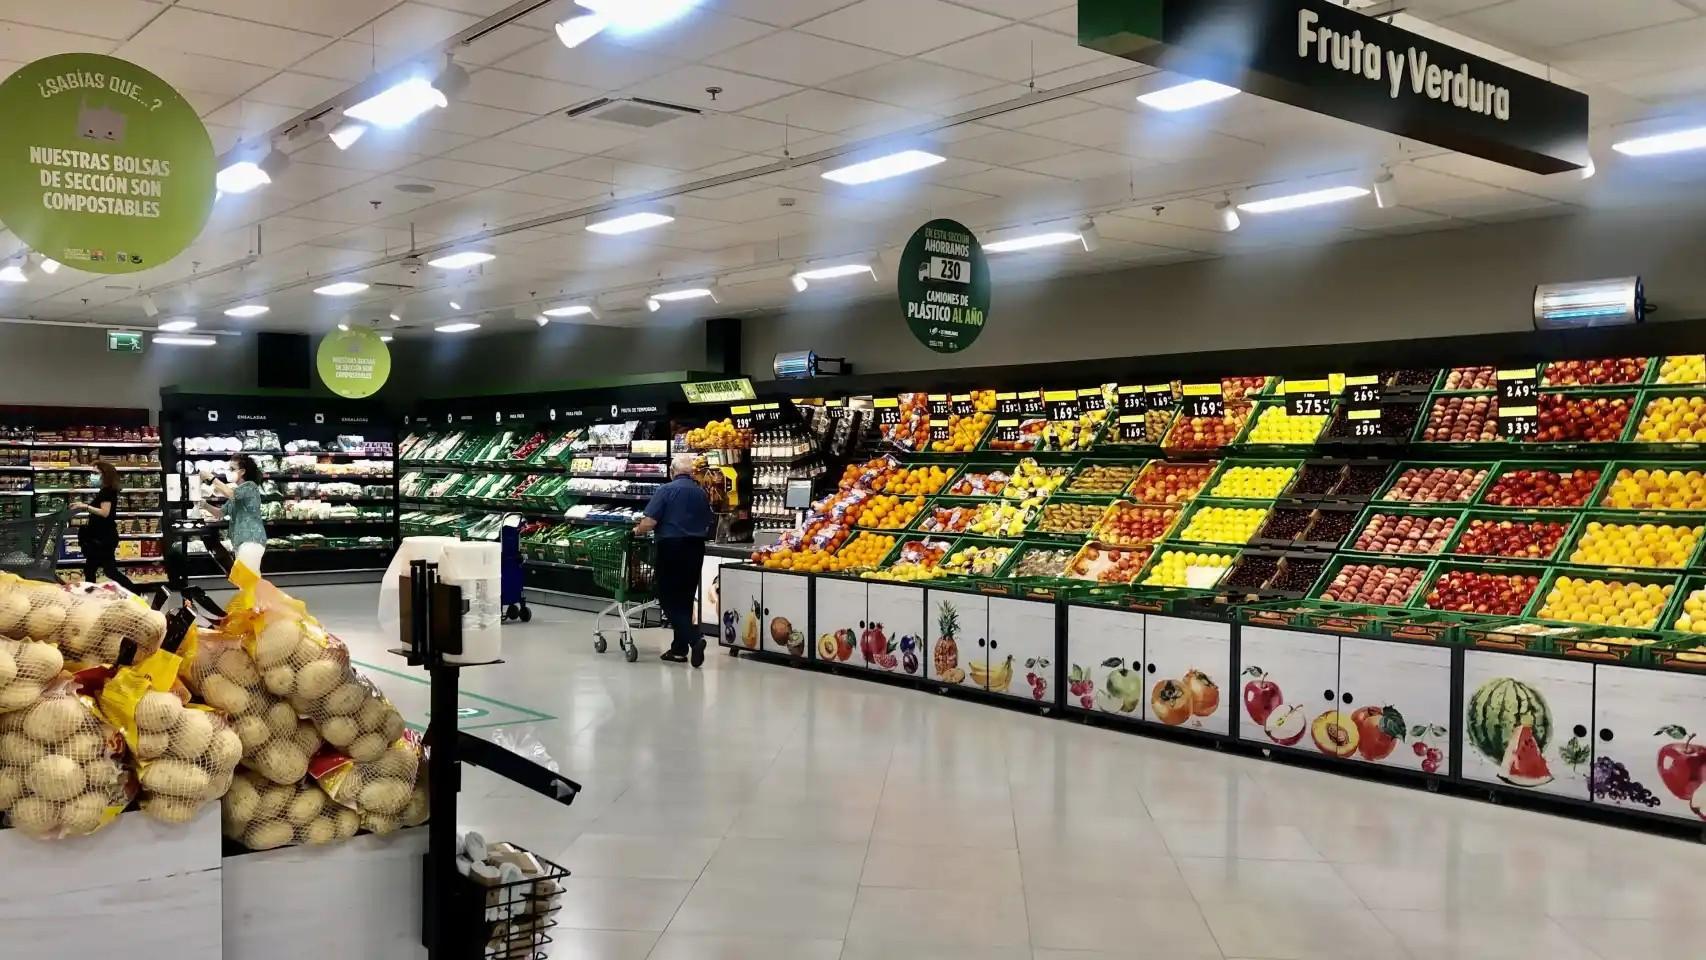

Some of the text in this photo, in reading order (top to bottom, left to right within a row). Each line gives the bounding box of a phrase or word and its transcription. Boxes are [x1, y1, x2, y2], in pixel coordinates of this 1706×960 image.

[1298, 8, 1511, 121] Fruta y Verdura
[39, 68, 105, 99] ¿SABÍAS
[29, 146, 170, 177] NUESTRAS BOLSAS
[40, 168, 161, 198] DE SECCIÓN SON
[43, 192, 160, 218] COMPOSTABLES
[925, 239, 969, 257] AHORRAMOS
[941, 260, 961, 281] 230
[926, 290, 969, 307] CAMIONES DE
[908, 301, 983, 327] PLÁSTICO AL AÑO
